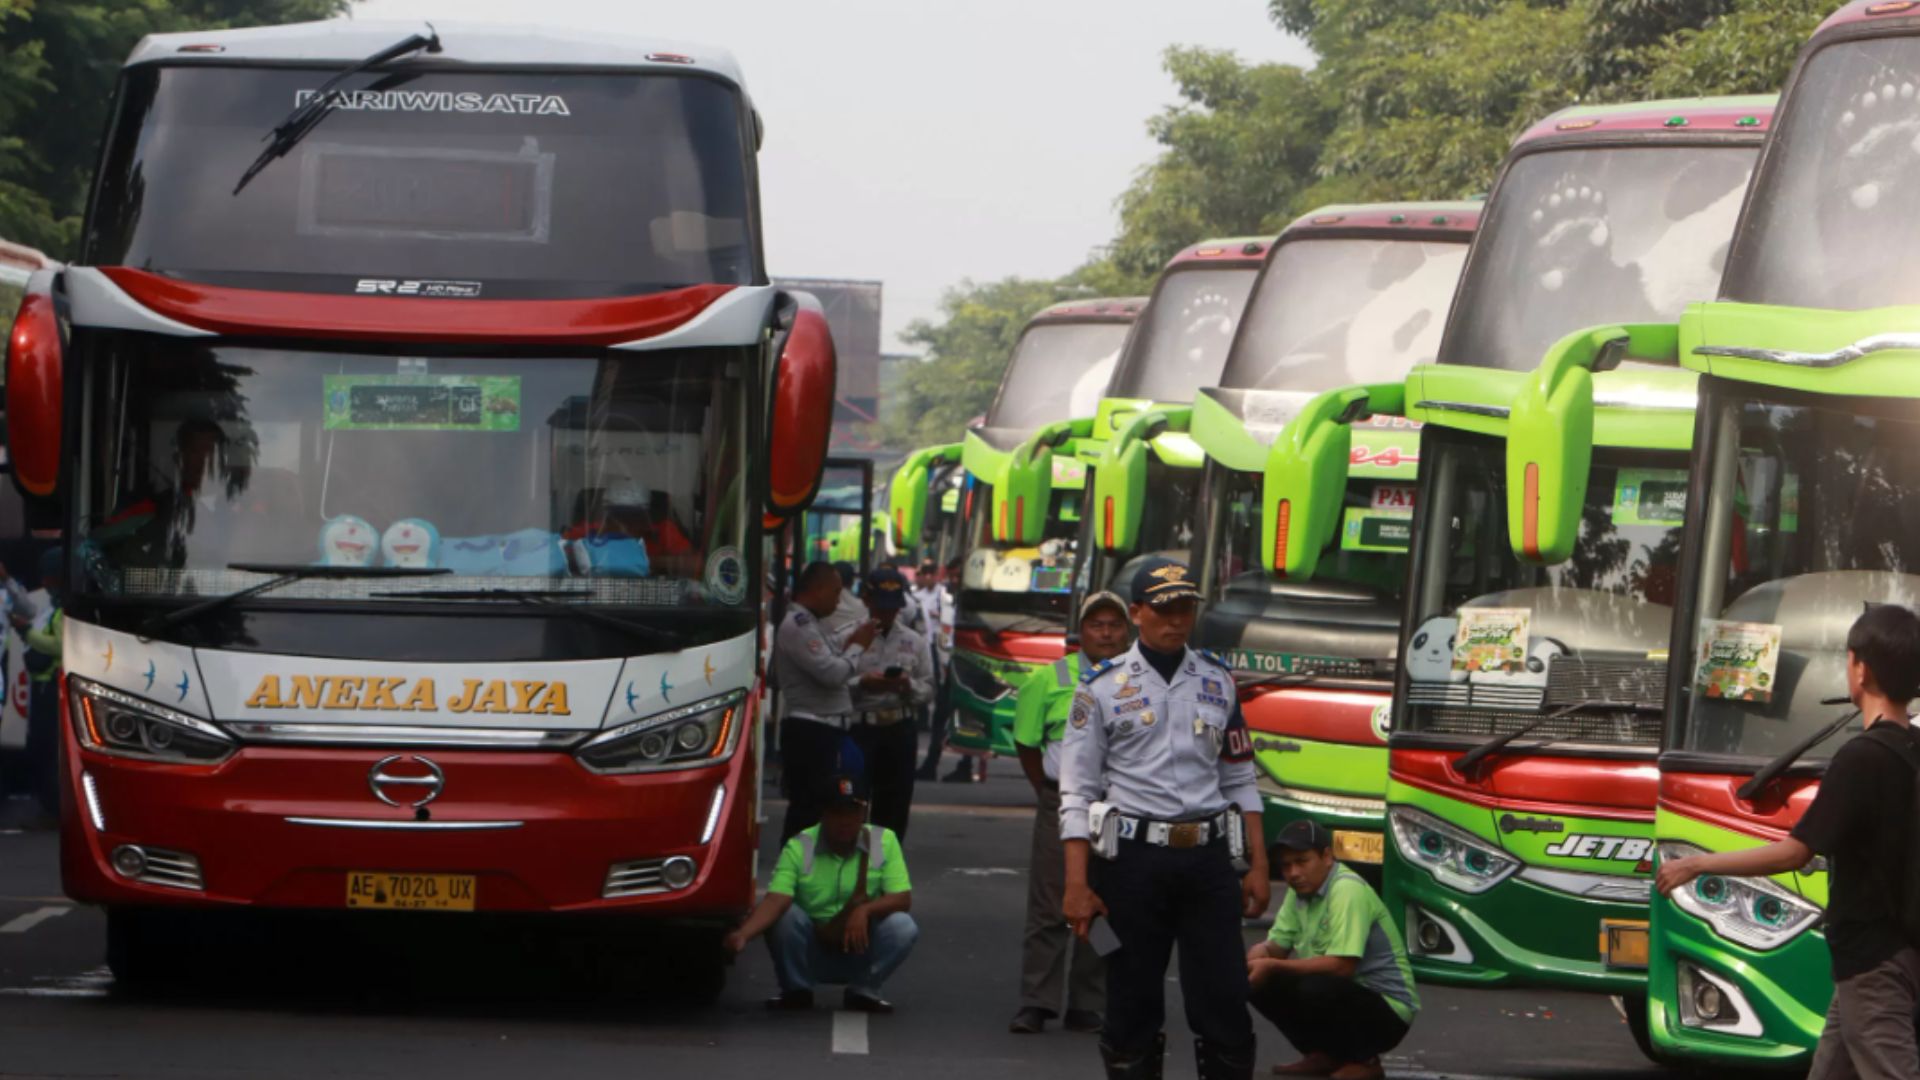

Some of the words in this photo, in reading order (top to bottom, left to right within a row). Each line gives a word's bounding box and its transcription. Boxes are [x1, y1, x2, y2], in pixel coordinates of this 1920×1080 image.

[295, 89, 571, 116] PARIWISATA
[1254, 653, 1286, 672] TOL
[245, 675, 438, 712] ANEKA
[447, 679, 571, 715] JAYA
[351, 875, 374, 897] AE
[388, 876, 436, 899] 7020
[448, 878, 473, 900] UX
